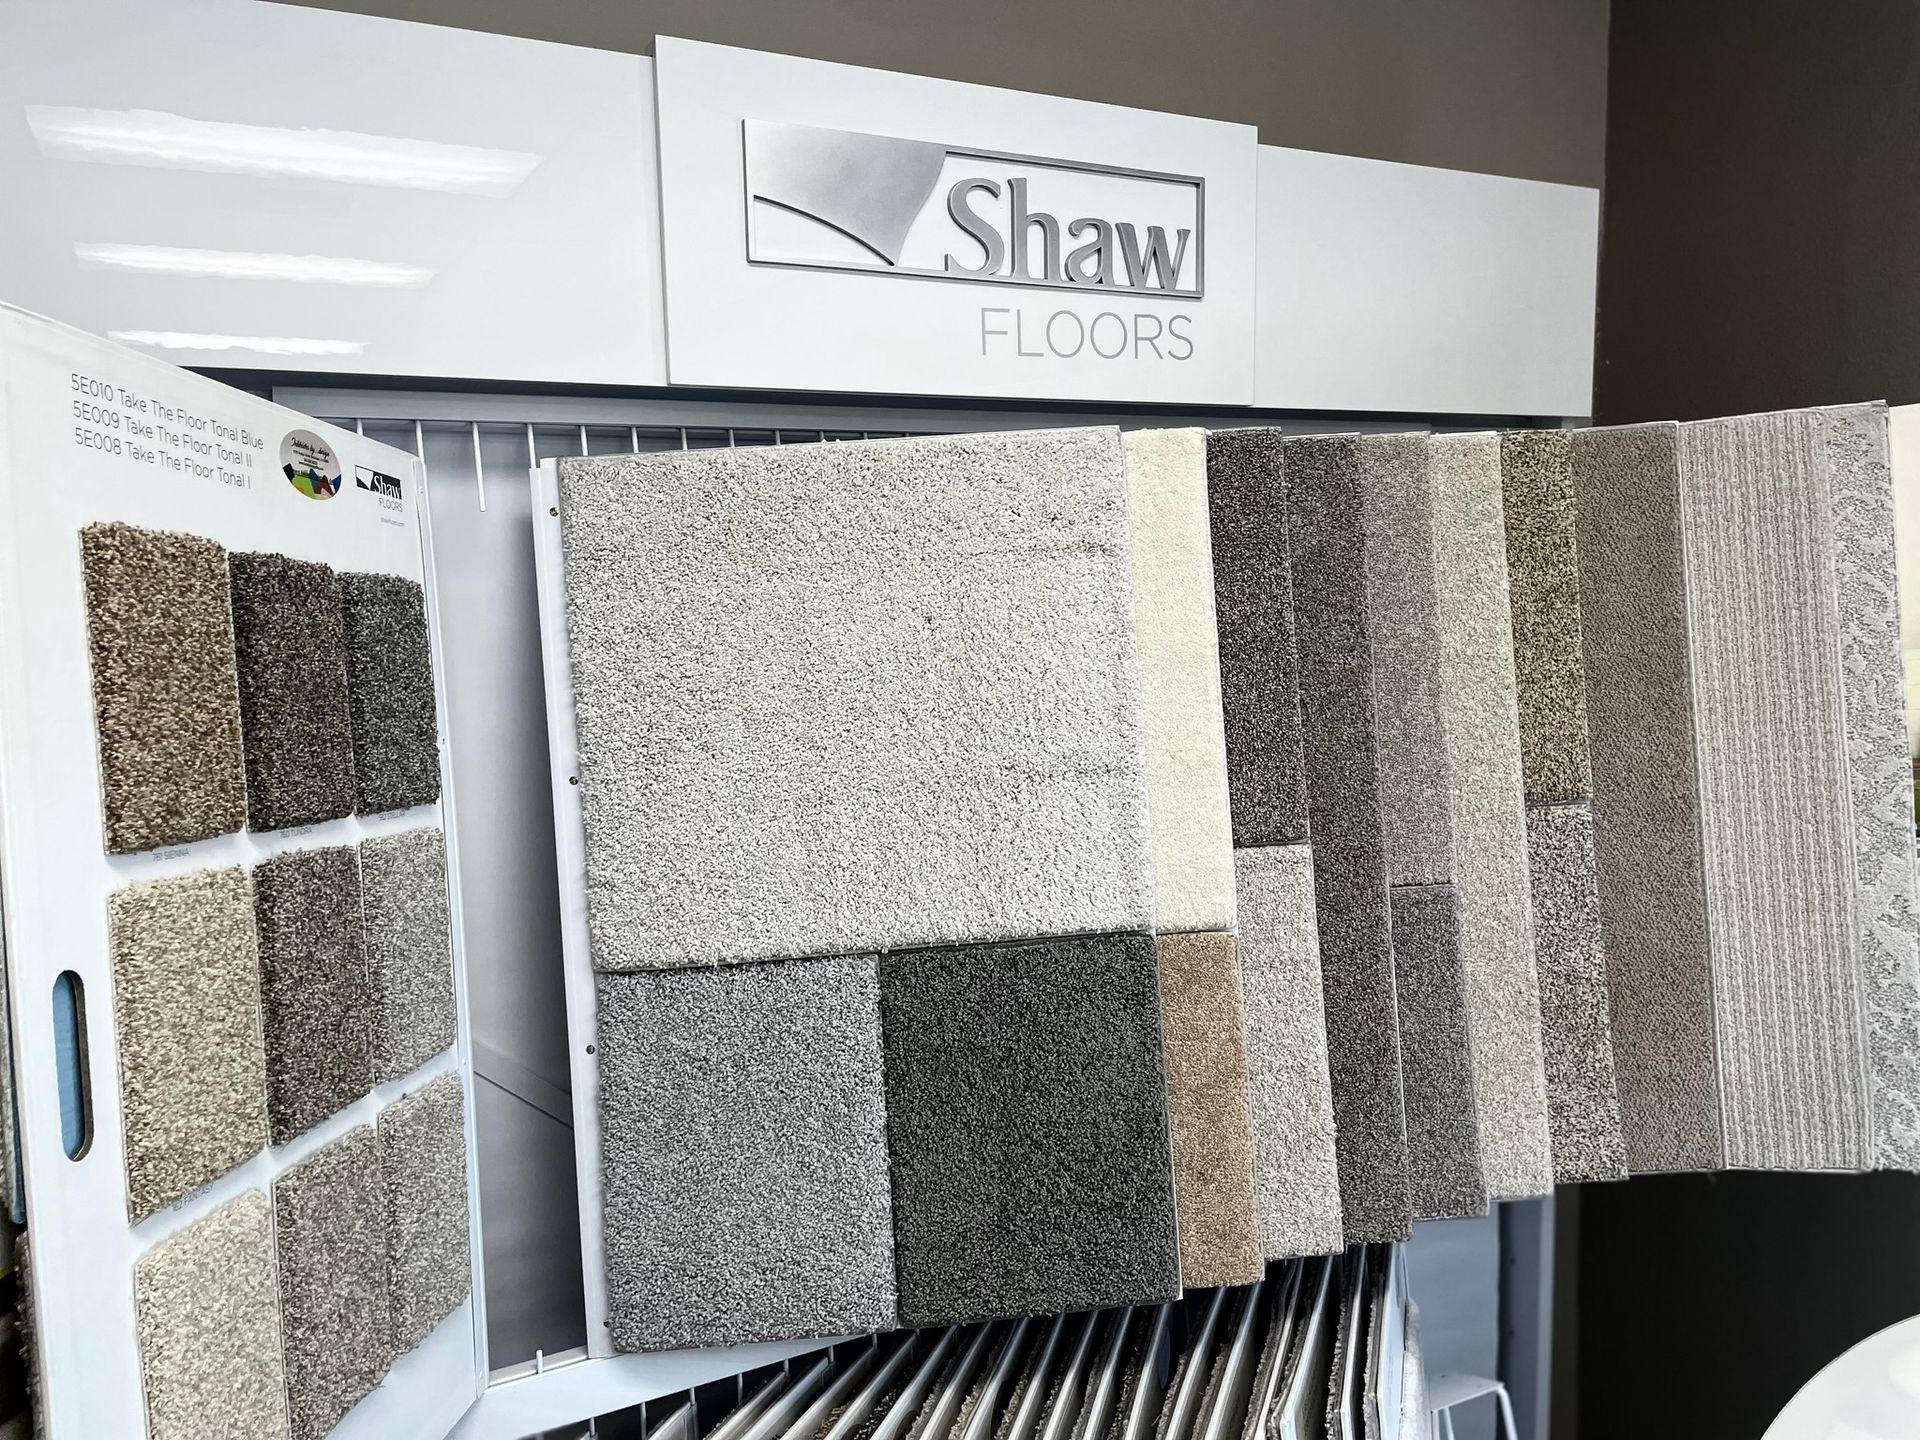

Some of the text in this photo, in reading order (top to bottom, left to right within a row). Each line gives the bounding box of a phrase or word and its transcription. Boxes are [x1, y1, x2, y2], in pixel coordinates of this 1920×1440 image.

[945, 177, 1192, 291] Shaw
[981, 308, 1194, 360] FLOORS
[71, 373, 264, 450] 5E010 Take The Floor Tonal Blue
[73, 400, 120, 429] 5E009
[123, 415, 153, 439] Take
[156, 425, 179, 447] The
[182, 433, 212, 456] Floor
[215, 443, 243, 465] Tonal
[75, 427, 122, 455] 5E008
[125, 441, 154, 464] Take
[158, 450, 181, 471] The
[184, 457, 214, 479] Floor
[217, 466, 245, 487] Tonal
[374, 475, 402, 500] Shaw
[378, 497, 403, 513] FLOORS
